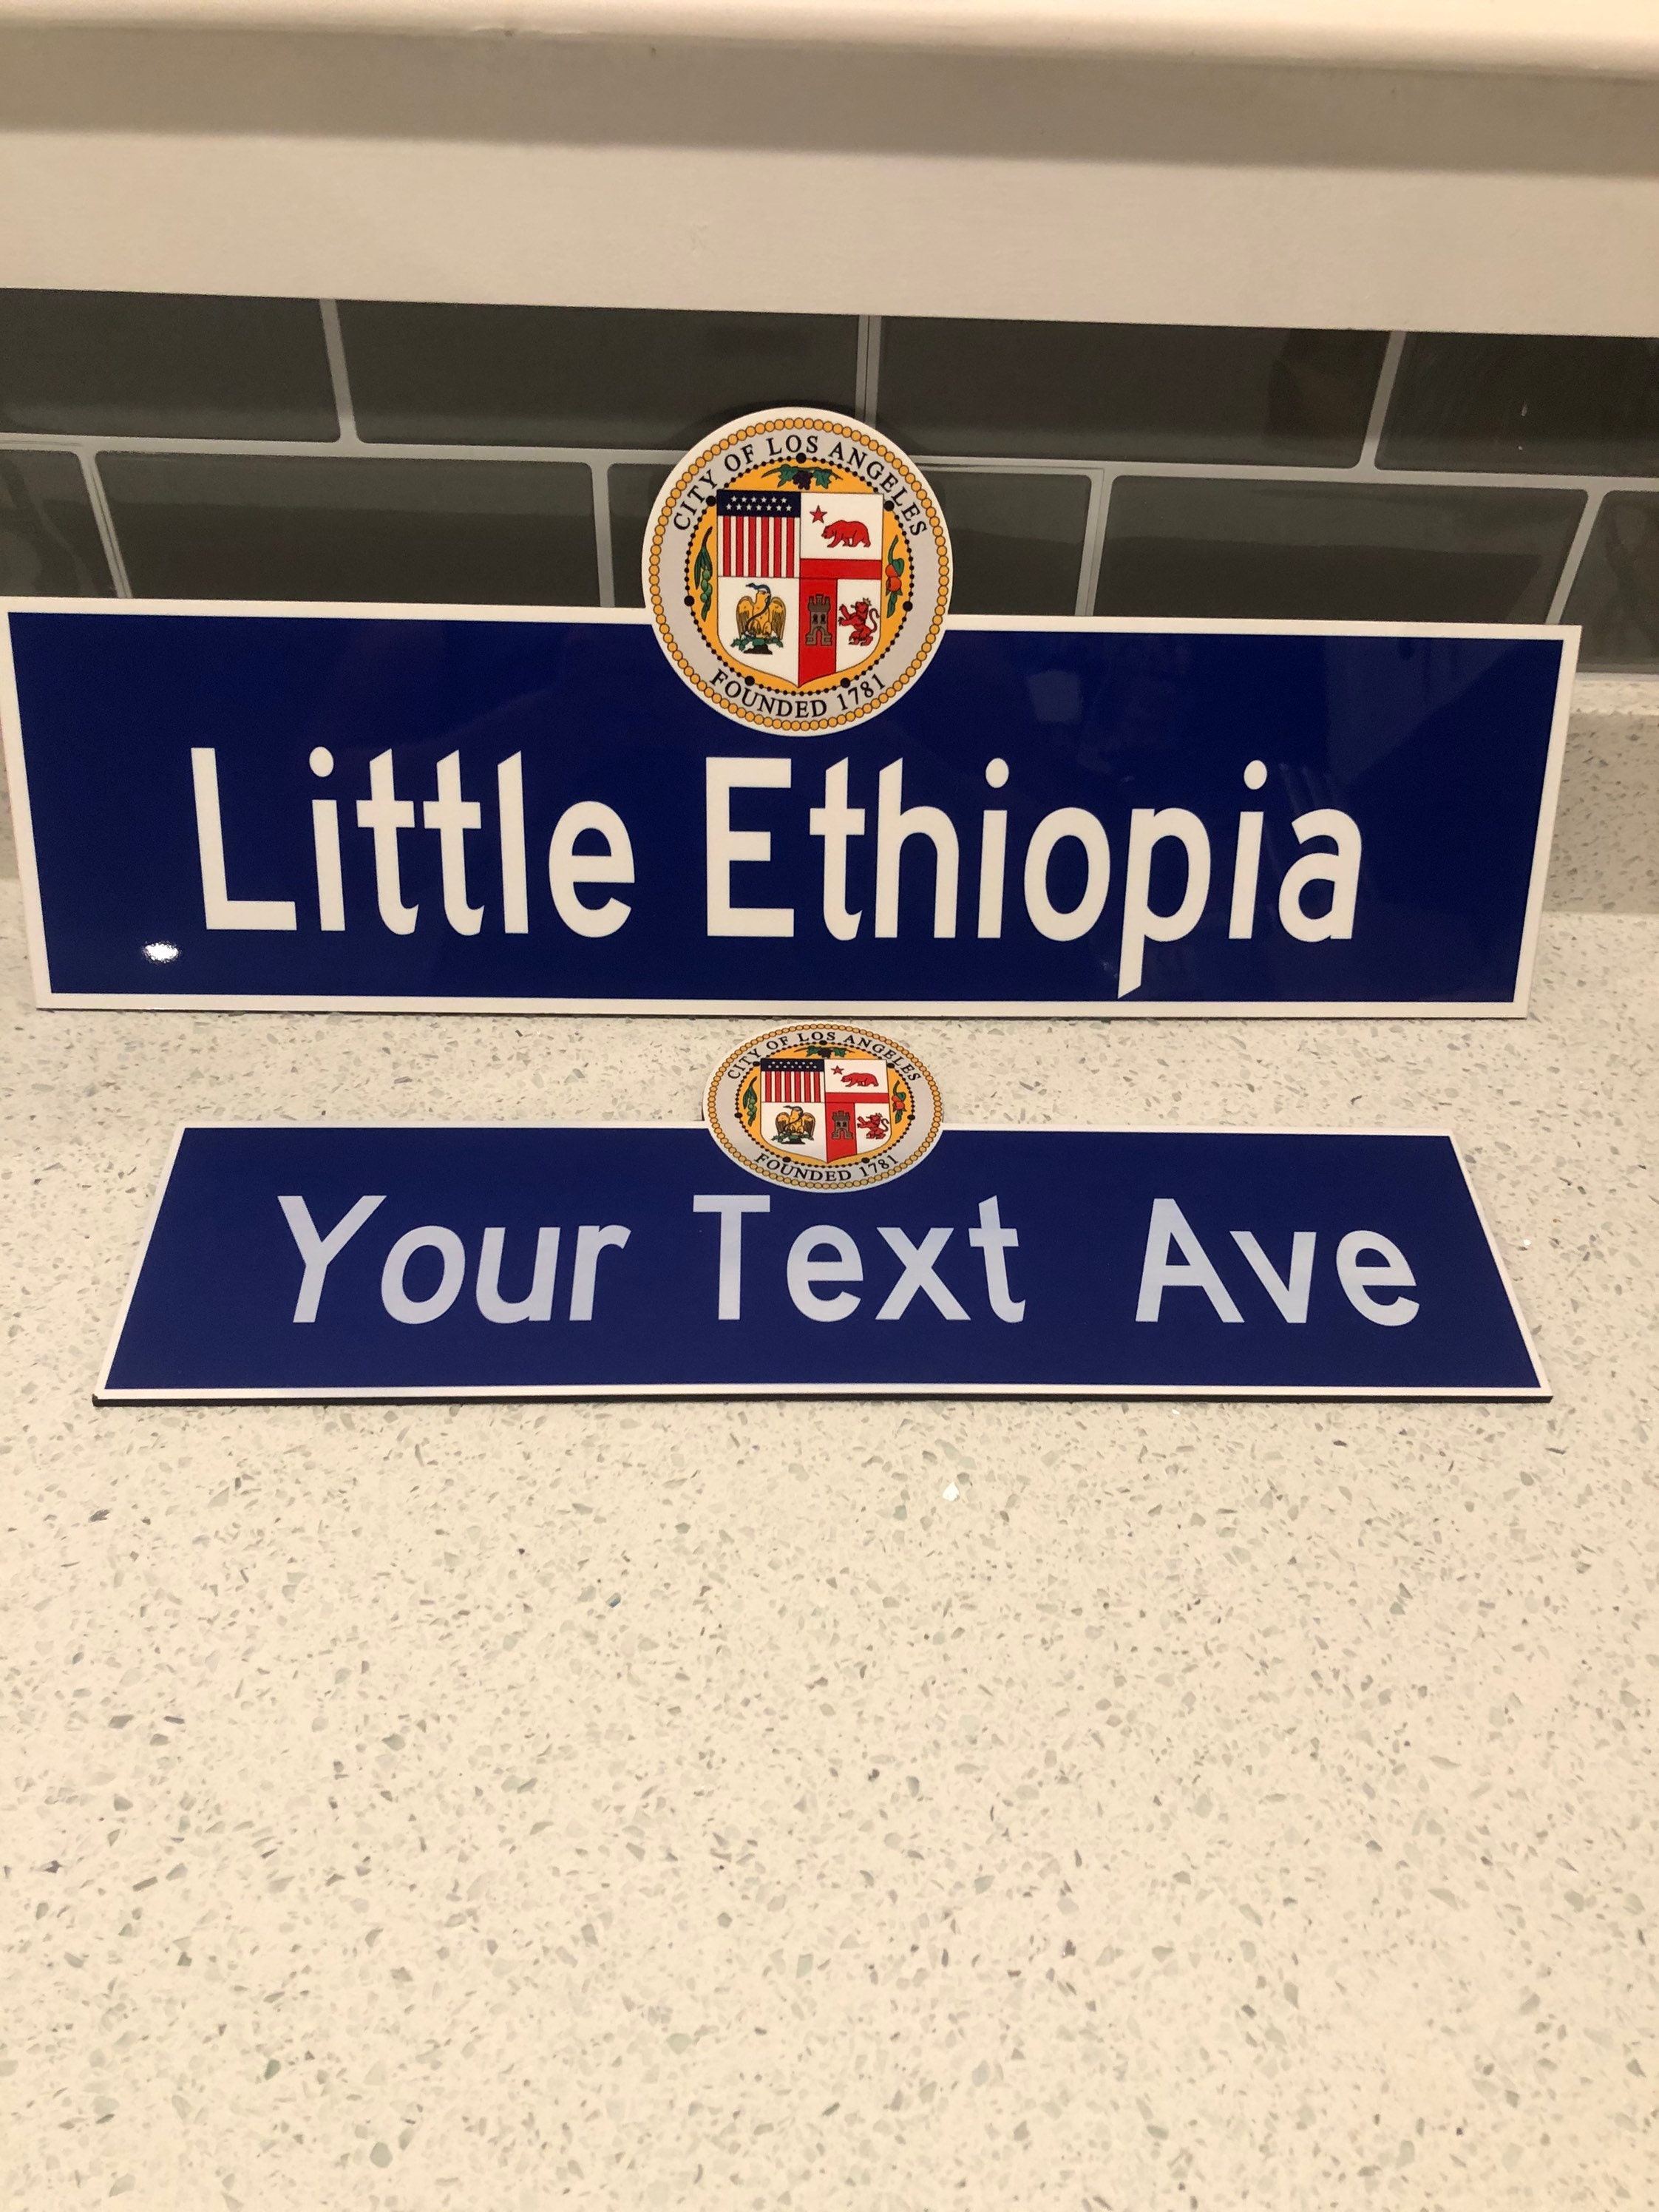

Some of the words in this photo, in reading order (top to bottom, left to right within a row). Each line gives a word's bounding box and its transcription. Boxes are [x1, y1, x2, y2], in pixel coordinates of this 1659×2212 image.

[674, 470, 720, 532] CITY
[725, 444, 756, 473] OF
[767, 435, 818, 455] LOS
[830, 442, 927, 537] ANGELES
[710, 669, 827, 719] FOUNDED
[837, 674, 886, 710] 1781
[191, 747, 635, 938] Little
[705, 756, 1362, 999] Ethiopia
[727, 1048, 762, 1079] CITY
[766, 1036, 789, 1050] OF
[797, 1031, 836, 1042] LOS
[844, 1035, 922, 1082] ANGELES
[753, 1153, 852, 1181] FOUNDED
[859, 1155, 899, 1178] 1781
[278, 1195, 631, 1325] Your
[693, 1194, 1026, 1323] Text
[1135, 1198, 1420, 1326] Ave
